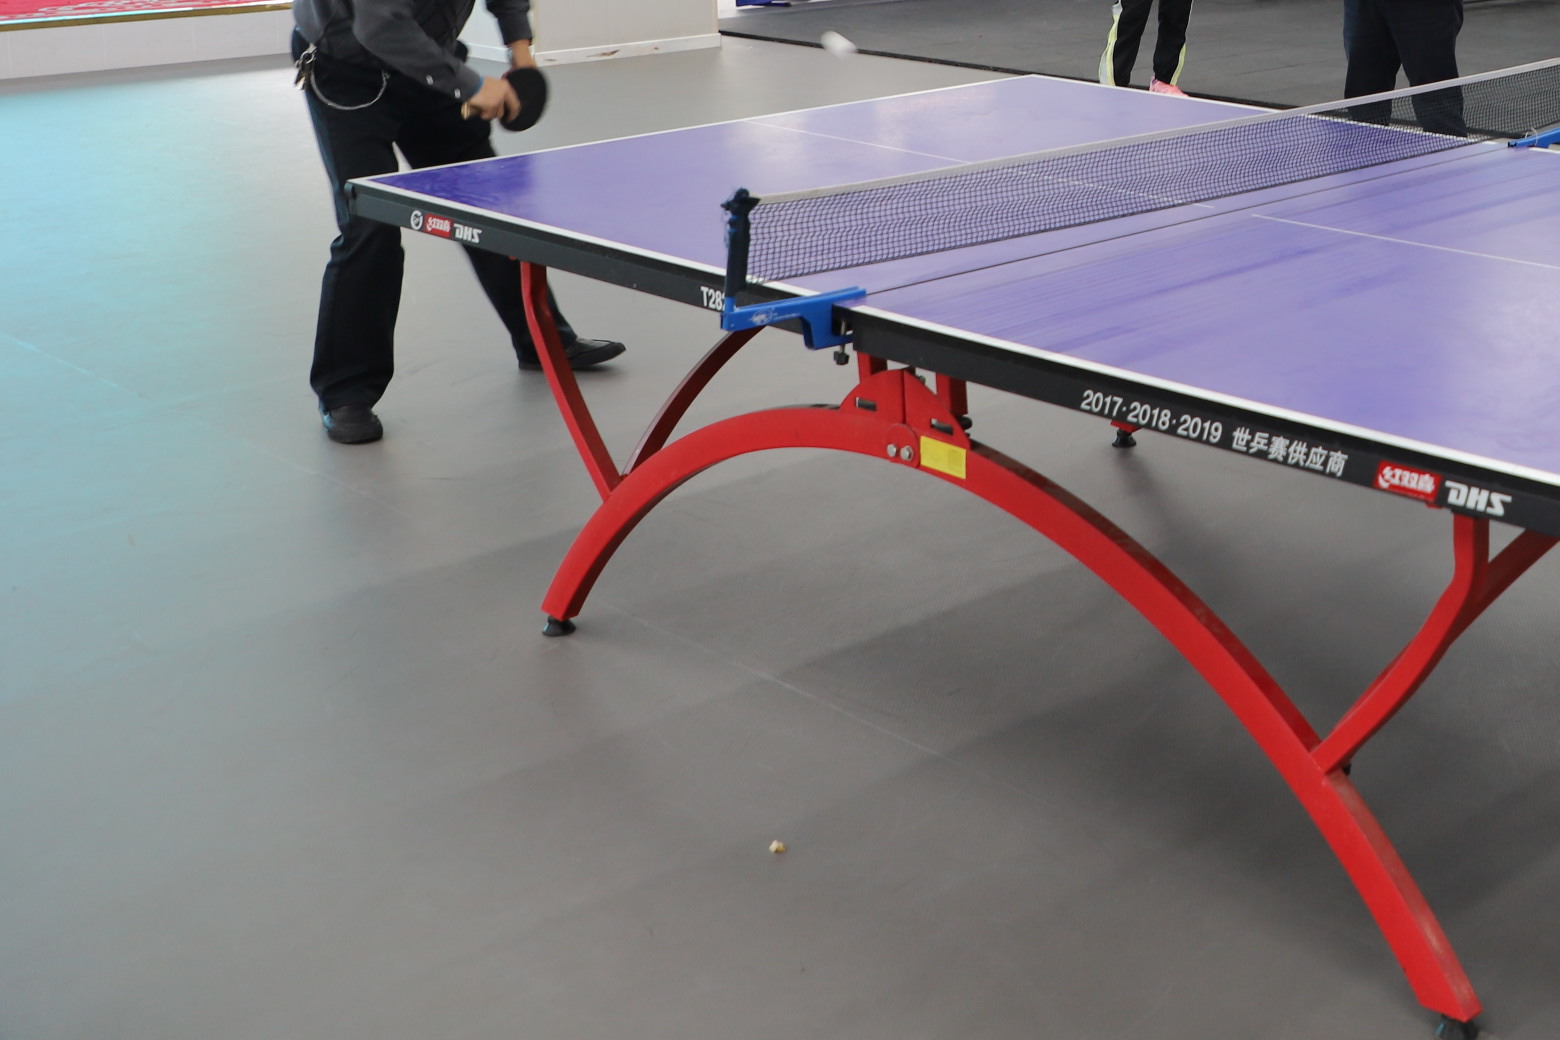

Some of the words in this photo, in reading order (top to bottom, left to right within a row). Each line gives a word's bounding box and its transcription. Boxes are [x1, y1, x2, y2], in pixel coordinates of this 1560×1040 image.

[453, 223, 482, 244] DHS
[1232, 427, 1349, 478] 世乒赛供应商
[1378, 465, 1435, 494] 红双喜
[1444, 480, 1512, 517] DHS
